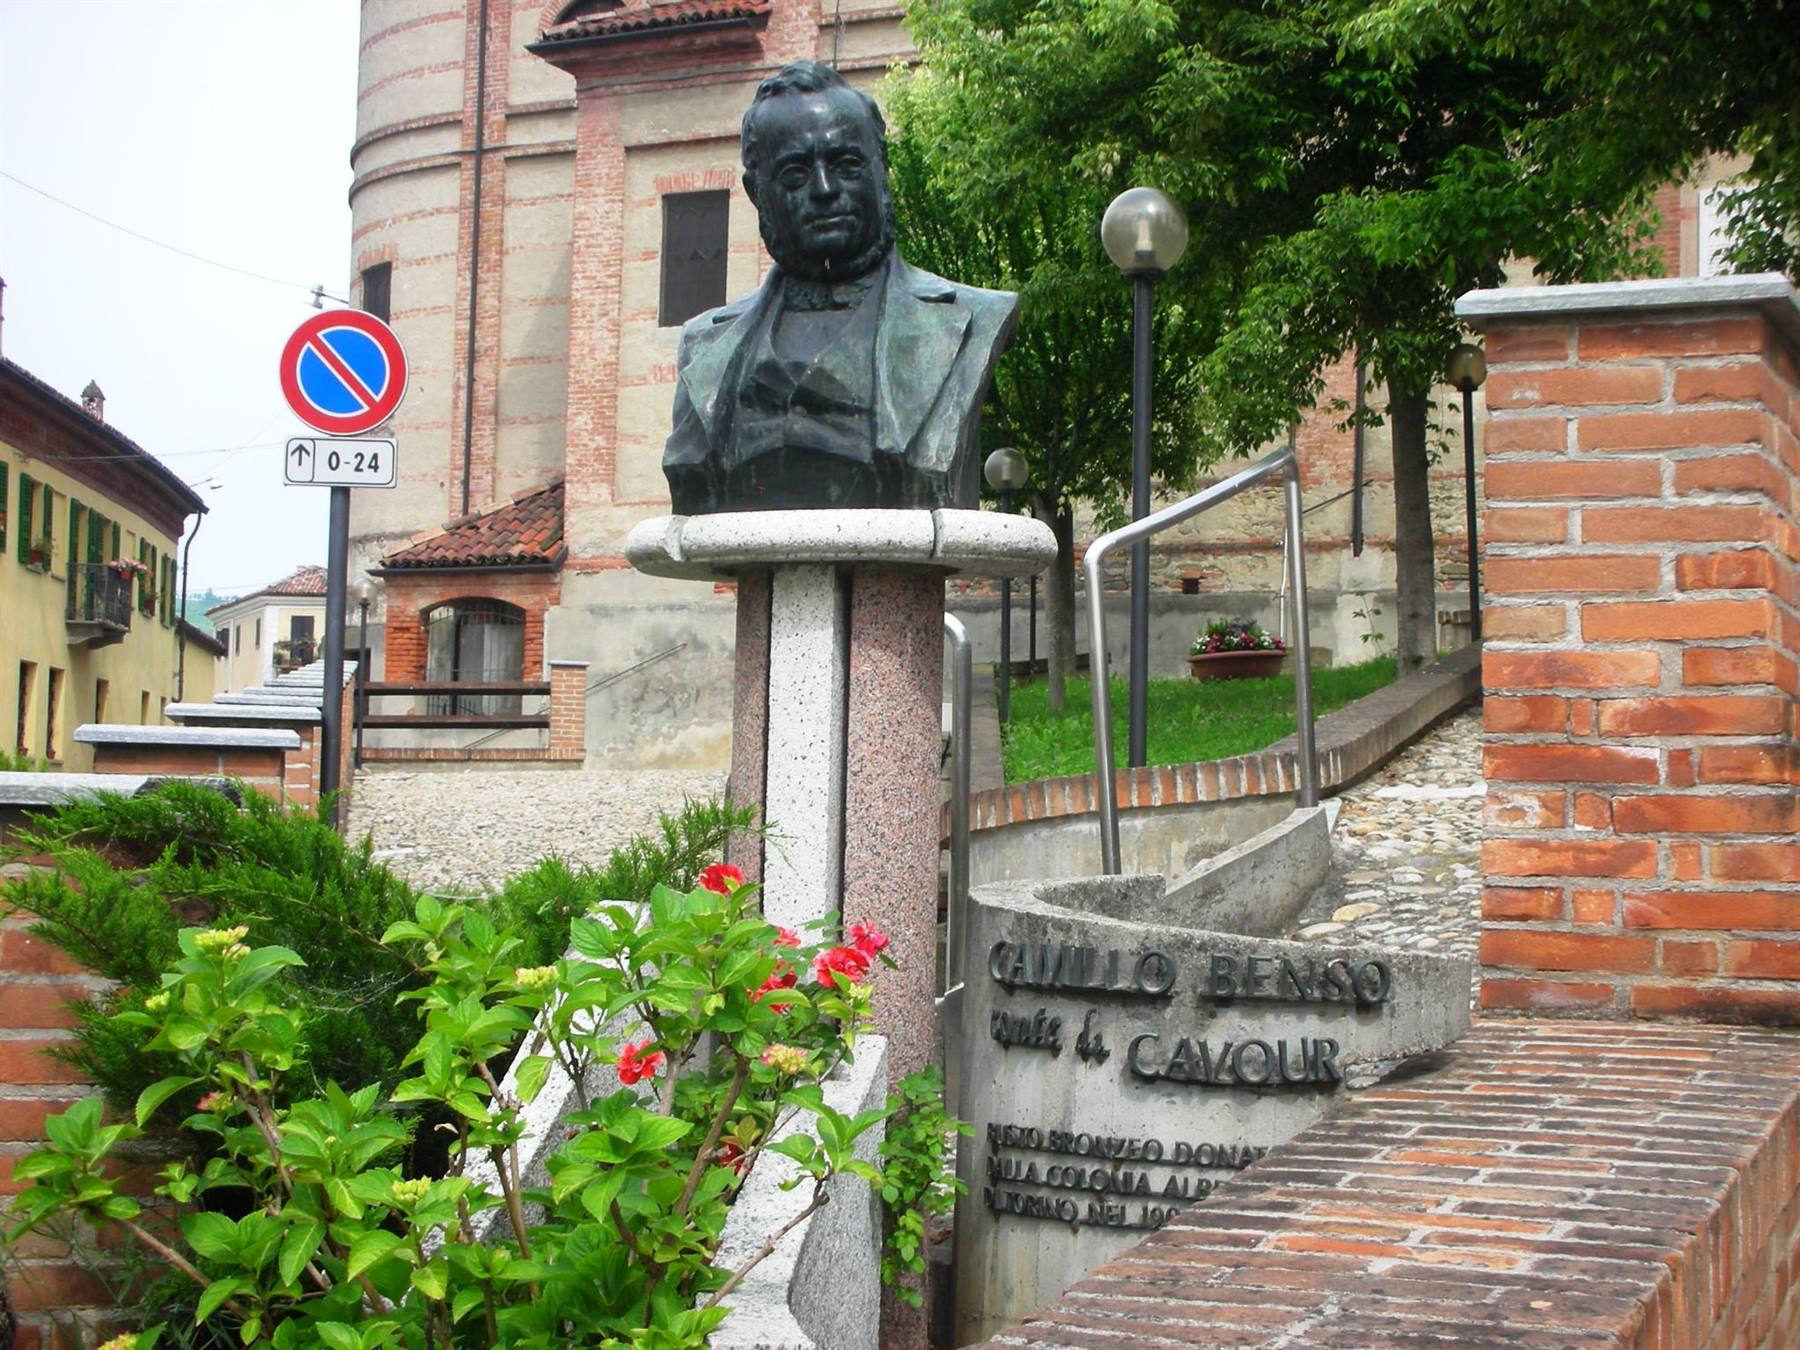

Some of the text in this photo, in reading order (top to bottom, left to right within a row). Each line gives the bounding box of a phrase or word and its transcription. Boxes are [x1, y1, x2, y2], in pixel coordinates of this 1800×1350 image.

[328, 451, 380, 473] 0-24
[988, 940, 1392, 1002] CAMILLO BENSO
[1127, 1032, 1342, 1085] CAVOUR
[986, 1122, 1044, 1149] BUSTO
[1048, 1130, 1164, 1162] BRONZEO
[985, 1156, 1041, 1184] DALLA
[1046, 1165, 1152, 1195] COLONIA
[1003, 1191, 1079, 1222] TORINO
[1088, 1202, 1128, 1227] NEL
